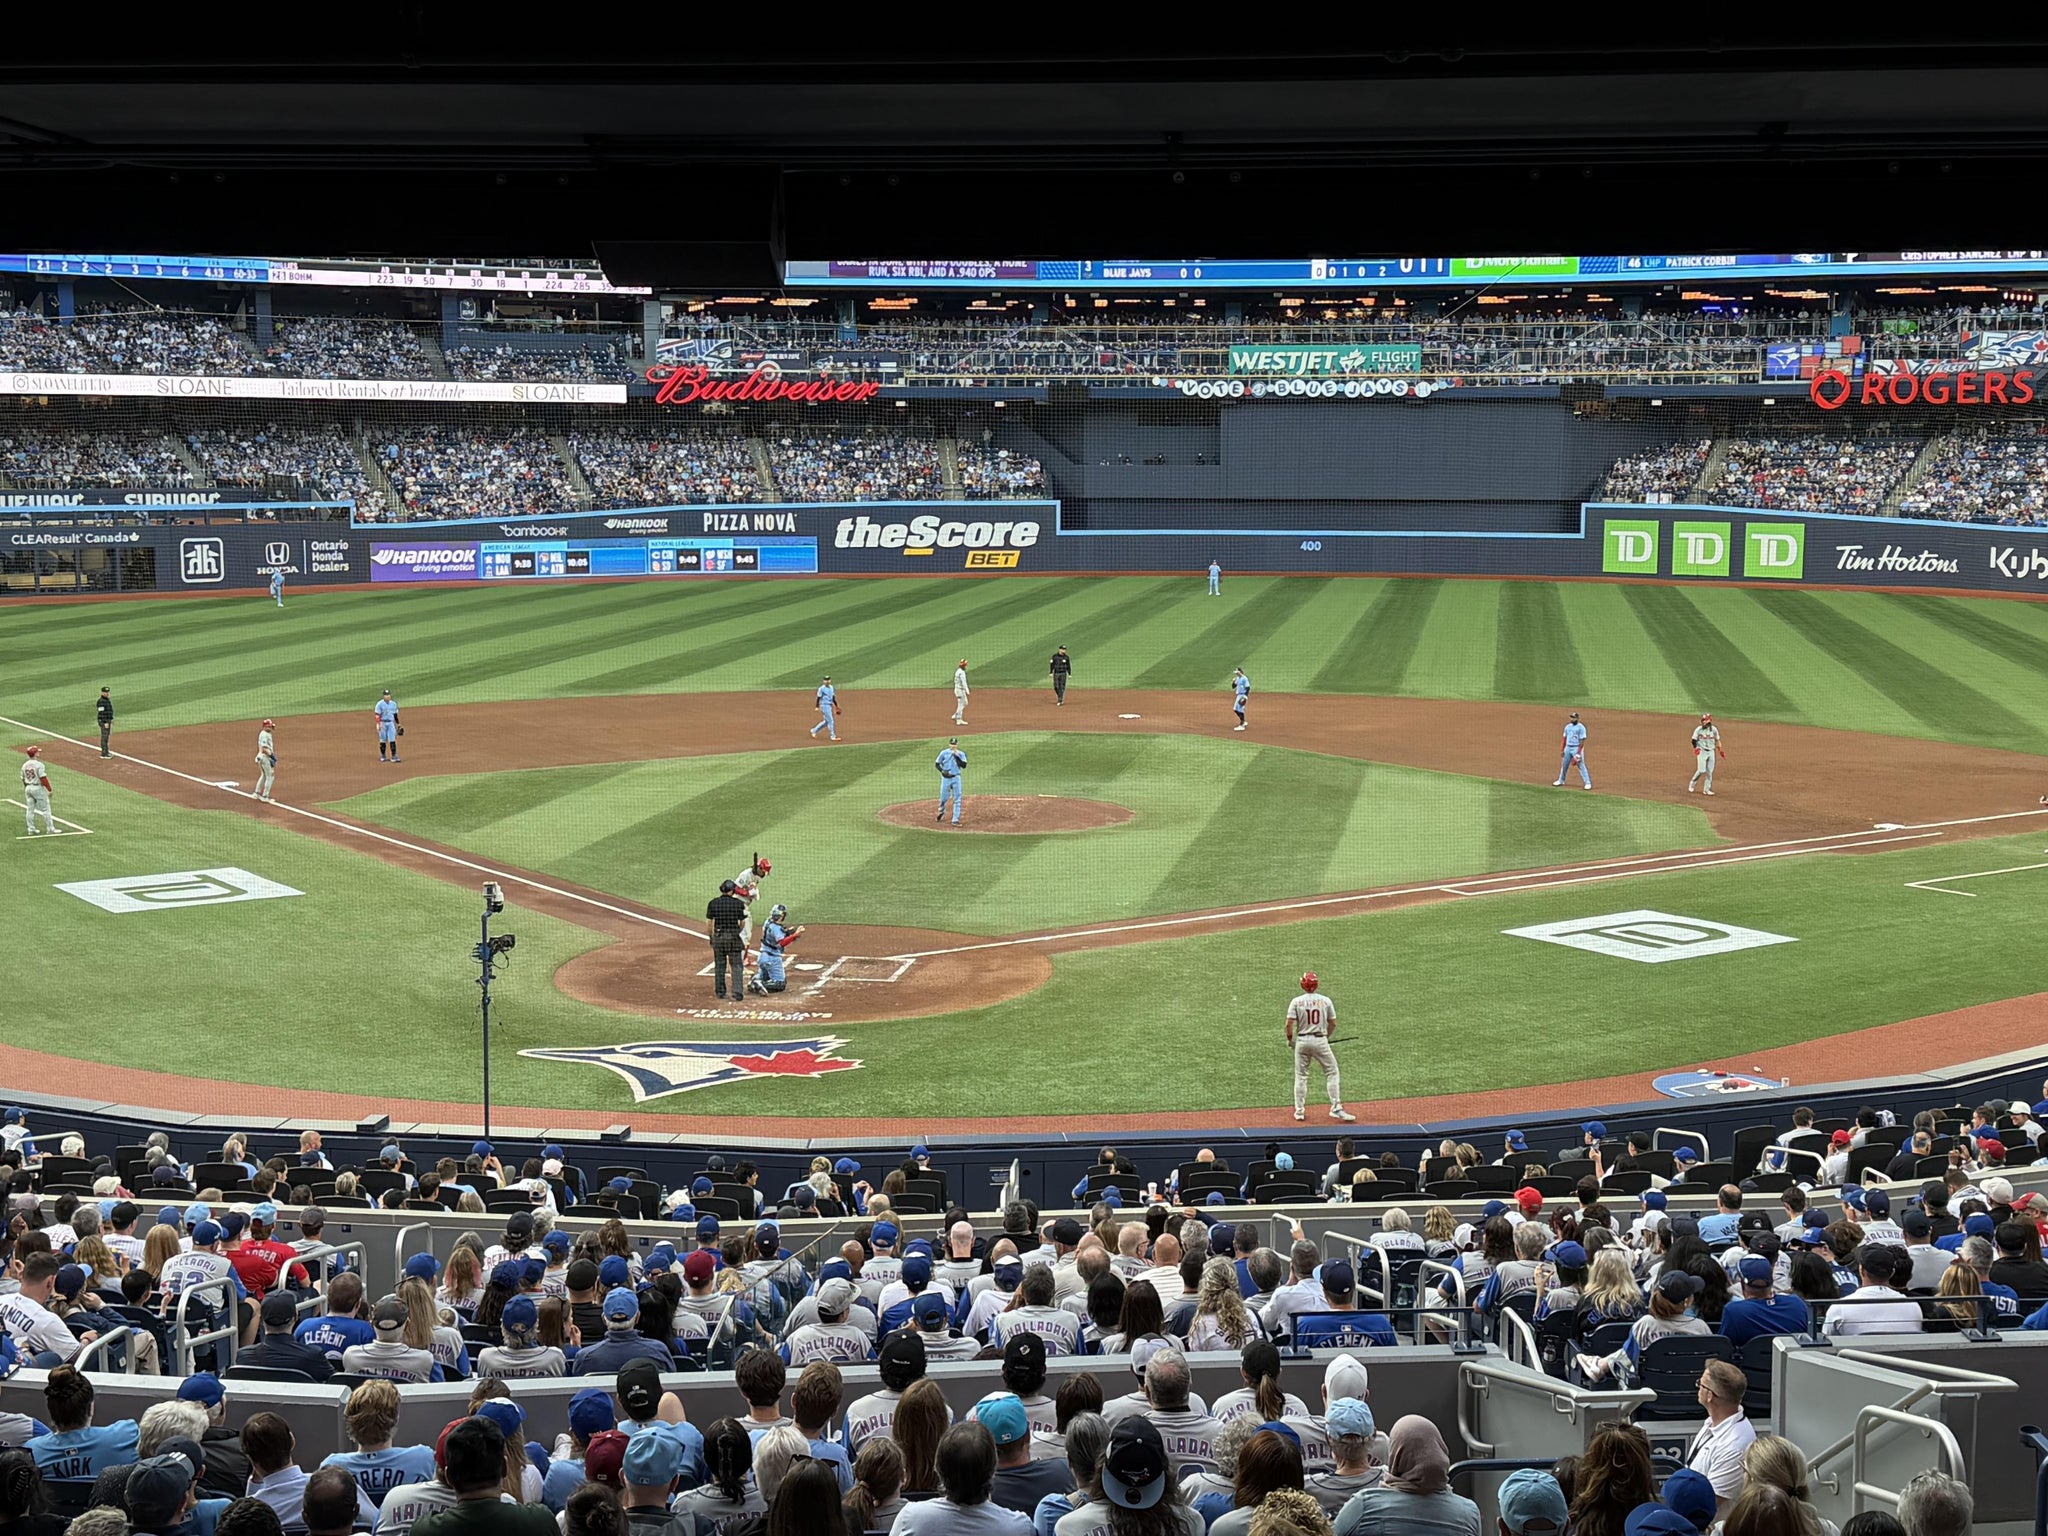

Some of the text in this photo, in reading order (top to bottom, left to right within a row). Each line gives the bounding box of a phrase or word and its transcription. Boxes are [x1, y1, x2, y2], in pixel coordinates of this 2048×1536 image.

[37, 260, 50, 271] 2.1
[62, 261, 68, 272] 2
[82, 262, 90, 273] 2
[105, 263, 113, 274] 2
[132, 264, 139, 275] 3
[156, 265, 163, 276] 3
[182, 266, 189, 277] 6
[1628, 255, 1736, 268] 46 LHP PATRICK CORBIN
[868, 267, 996, 278] RUN, SIX RBI, AND A .940 OPS
[1103, 268, 1127, 279] BLUE
[1128, 268, 1151, 279] JAYS
[1180, 267, 1188, 279] 0
[1194, 267, 1202, 279] 0
[1329, 266, 1336, 277] 0
[1342, 266, 1348, 277] 1
[1358, 266, 1366, 277] 0
[1379, 265, 1386, 277] 2
[289, 271, 313, 281] BOHM
[377, 274, 395, 285] 223
[404, 275, 413, 285] 19
[424, 276, 435, 286] 50
[448, 277, 454, 287] 7
[471, 278, 483, 288] 30
[496, 278, 506, 289] 18
[542, 279, 563, 290] .224
[571, 280, 591, 291] .285
[1233, 351, 1419, 375] WESTJET FLIGHT
[157, 378, 233, 395] SLOANE
[279, 379, 333, 396] Tailored
[337, 380, 387, 397] Rentals
[390, 384, 405, 397] at
[407, 384, 465, 399] Yorkdale
[512, 385, 585, 401] SLOANE
[646, 364, 879, 404] Budweiser
[1186, 380, 1405, 396] VOTE BLUE JAYS
[1861, 371, 2034, 405] ROGERS
[703, 512, 796, 532] PIZZA NOVA
[11, 532, 129, 545] CLEAResult Canada
[834, 515, 1040, 548] theScore
[311, 540, 349, 551] Ontario
[1300, 541, 1321, 551] 400
[1610, 530, 1653, 562] TD
[1679, 532, 1724, 565] TD
[1751, 533, 1798, 567] TD
[312, 551, 344, 561] Honda
[970, 553, 1016, 565] BET
[1836, 545, 1959, 573] Tim Hortons
[312, 562, 350, 572] Dealers
[412, 564, 475, 574] driving emotion
[1305, 1009, 1320, 1025] 10
[0, 1302, 35, 1333] AMOTO
[1007, 1321, 1069, 1338] HALLADAY
[304, 1332, 347, 1348] CLEMENT
[799, 1336, 861, 1356] HALLADAY
[1320, 1333, 1375, 1348] CLEMENT
[52, 1457, 93, 1478] KIRK
